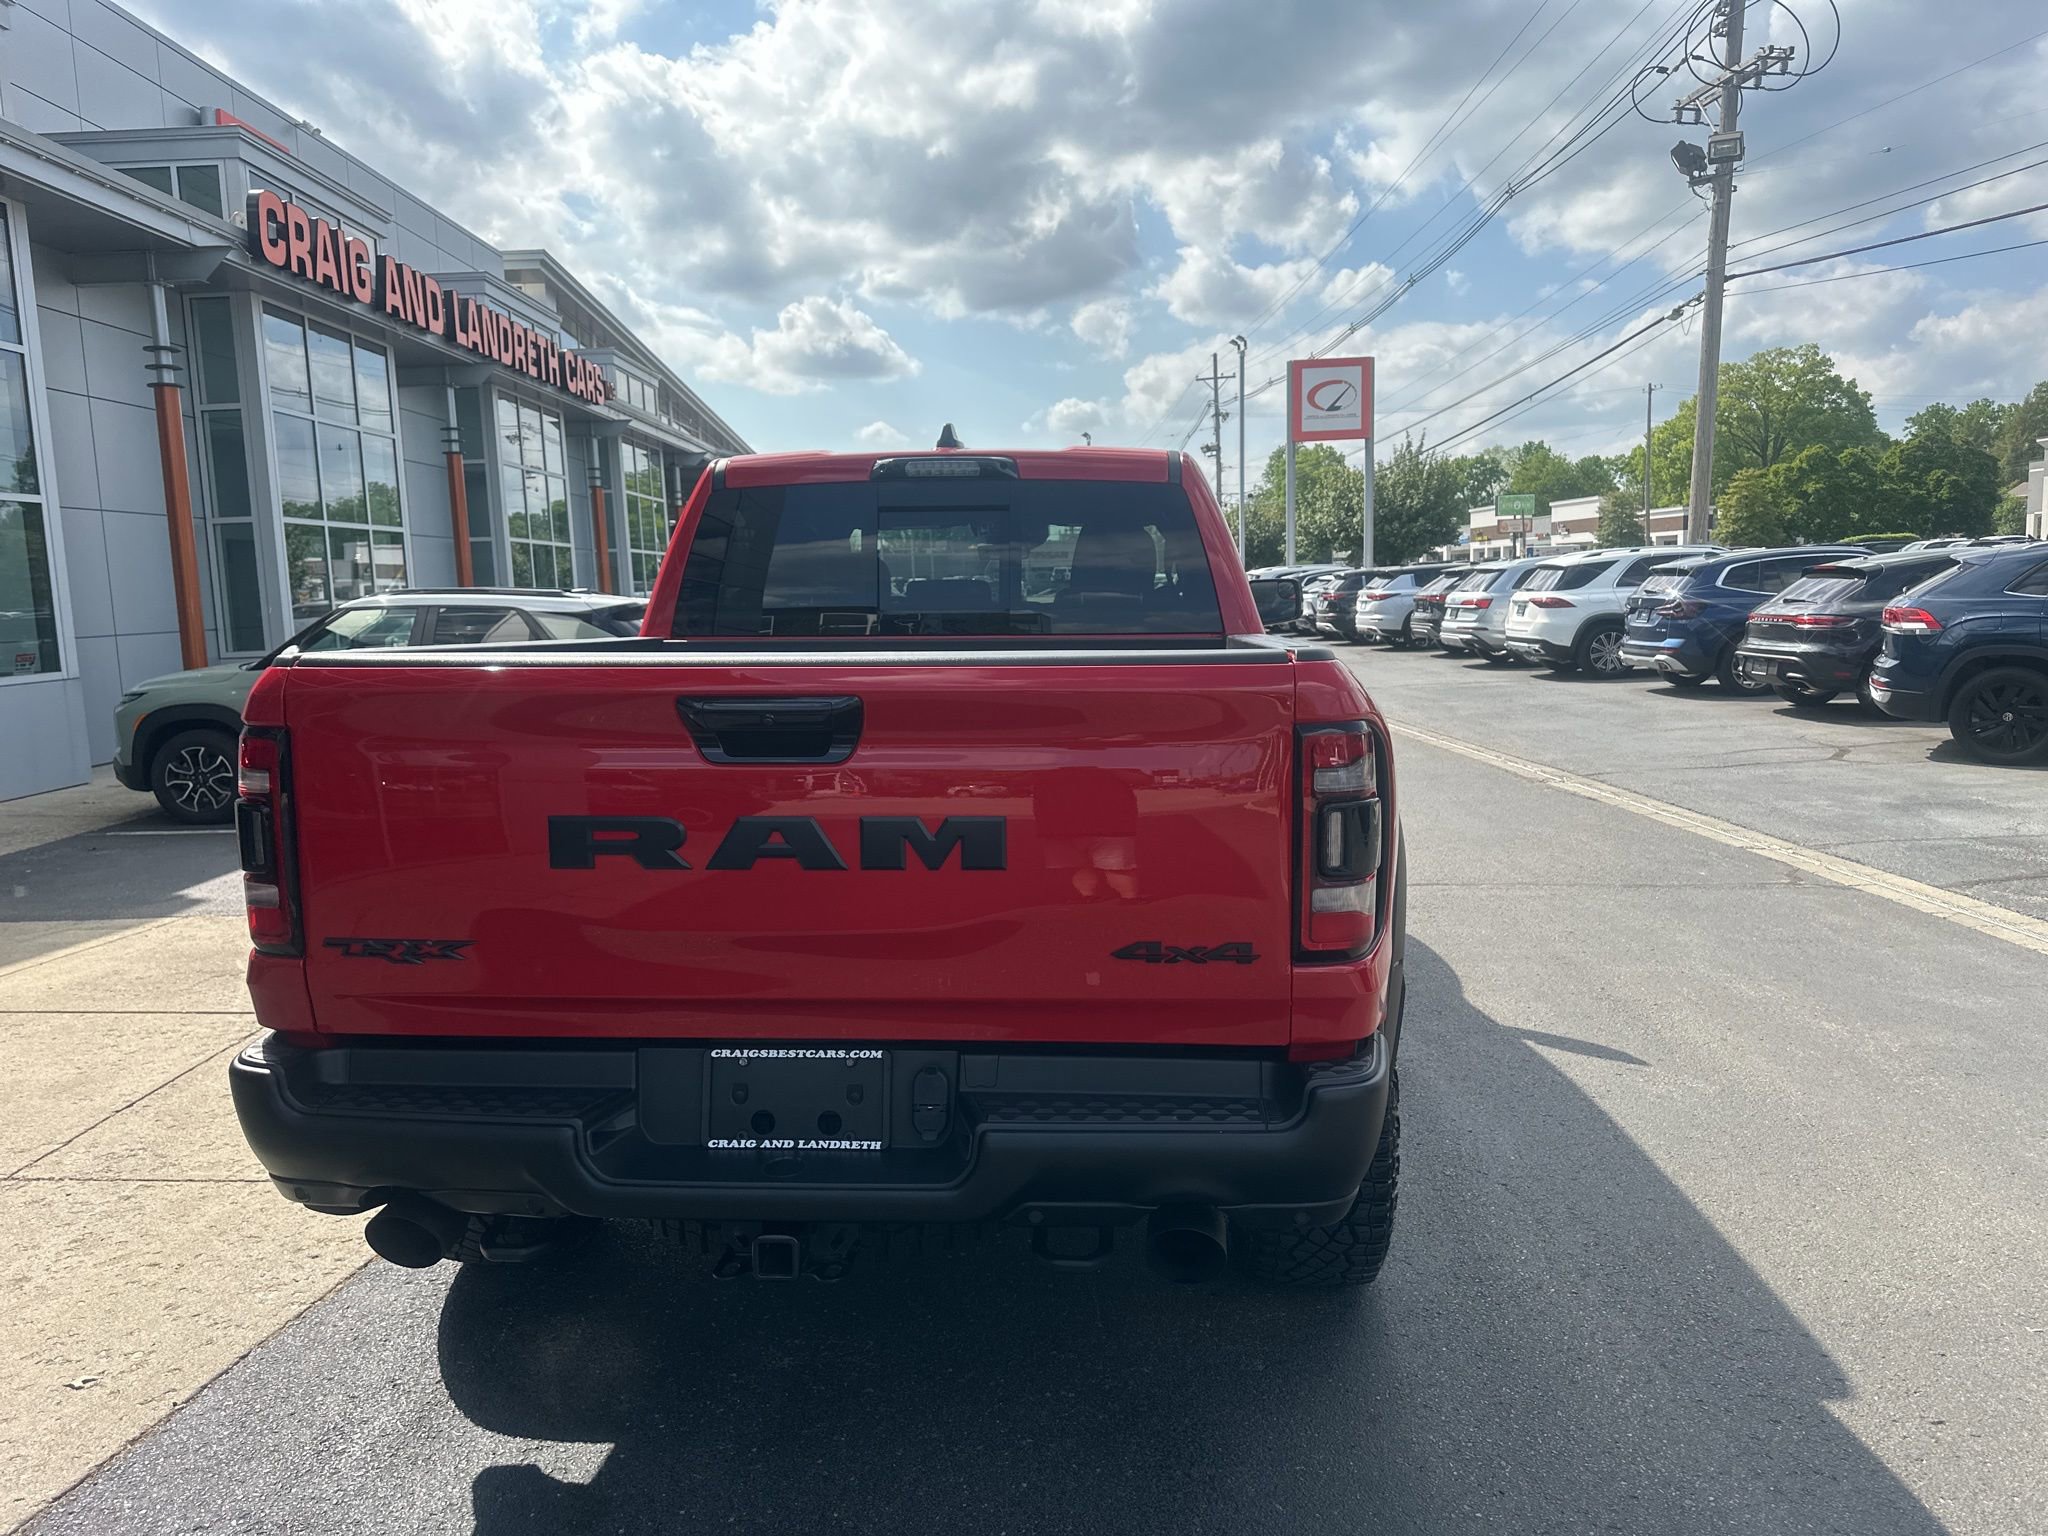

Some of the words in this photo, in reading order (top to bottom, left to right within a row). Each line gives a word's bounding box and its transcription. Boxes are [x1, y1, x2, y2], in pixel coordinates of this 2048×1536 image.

[256, 189, 373, 304] CRAIG
[384, 254, 445, 336] AND
[452, 289, 561, 388] LANDRETH
[564, 350, 606, 406] CARS
[547, 815, 1008, 871] RAM
[322, 936, 480, 965] TRX
[1110, 940, 1262, 964] 4x4
[710, 1048, 884, 1060] CRAIGSBESTCARS.COM
[706, 1138, 758, 1149] CRAIG
[759, 1139, 795, 1149] AND
[797, 1139, 883, 1150] LANDRETH
